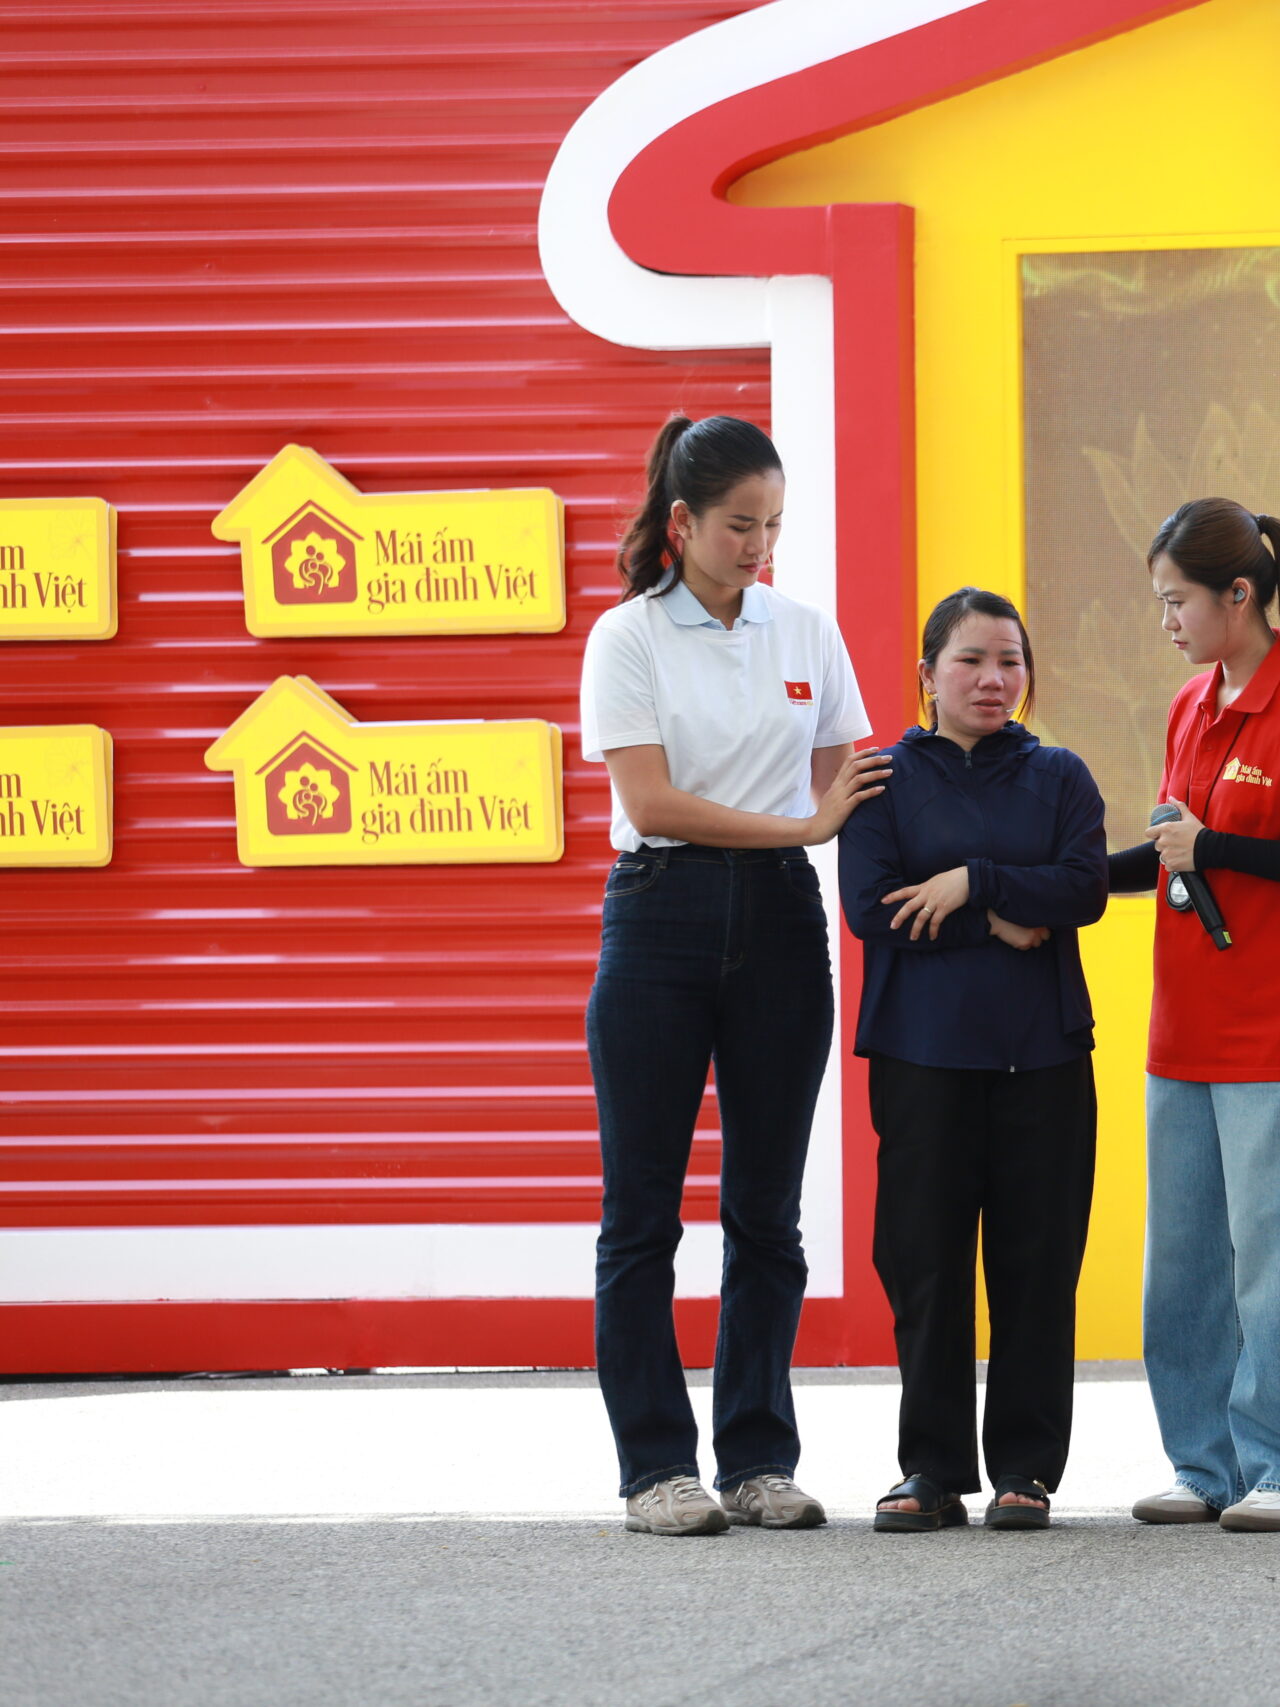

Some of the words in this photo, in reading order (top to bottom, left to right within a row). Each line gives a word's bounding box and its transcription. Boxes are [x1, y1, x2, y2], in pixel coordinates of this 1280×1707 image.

[0, 545, 25, 571] m
[375, 530, 424, 566] Mái
[432, 526, 475, 564] ấm
[33, 572, 88, 614] Việt
[366, 572, 407, 615] gia
[415, 566, 479, 604] đình
[484, 564, 538, 606] Việt
[0, 773, 22, 799] m
[369, 760, 418, 797] Mái
[426, 757, 469, 795] ấm
[30, 799, 86, 841] Việt
[361, 803, 402, 845] gia
[409, 797, 473, 834] đình
[478, 795, 534, 837] Việt
